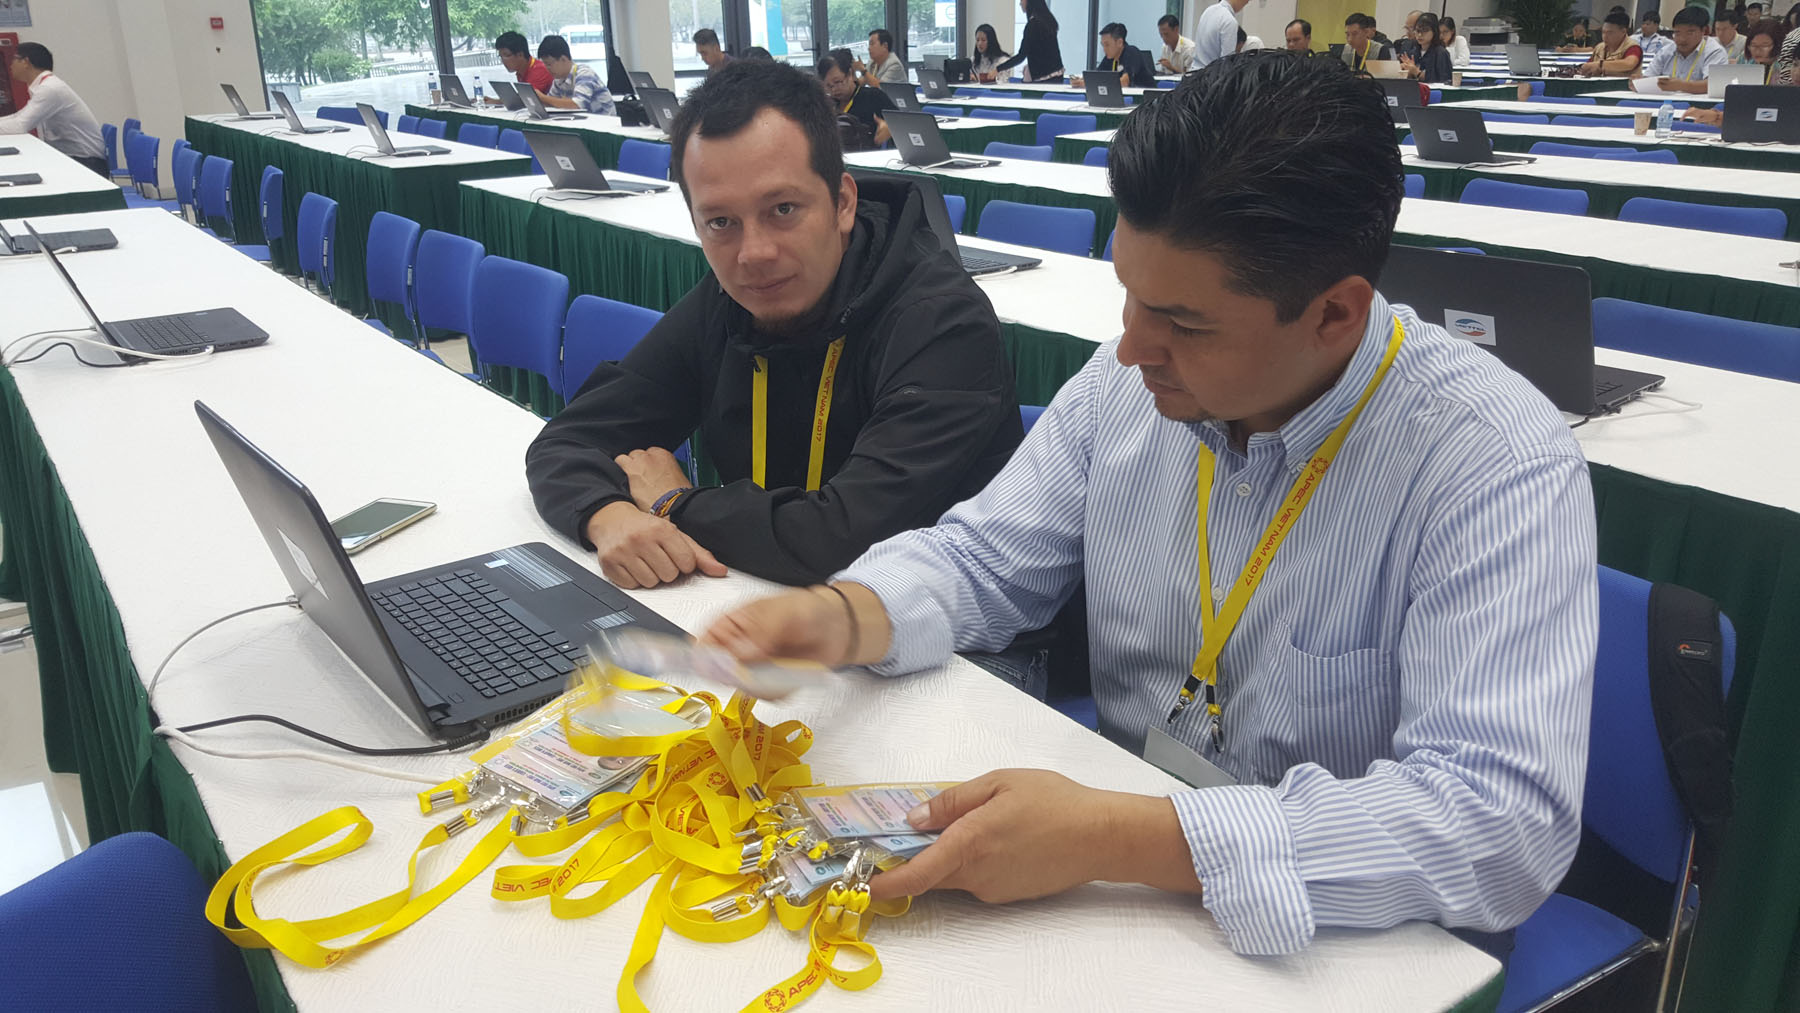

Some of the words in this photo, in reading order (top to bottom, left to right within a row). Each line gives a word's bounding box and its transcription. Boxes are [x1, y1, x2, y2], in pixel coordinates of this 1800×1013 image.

[816, 418, 824, 442] 2017
[1292, 472, 1315, 504] APEC
[1245, 557, 1263, 585] 2017
[557, 858, 580, 887] 2017
